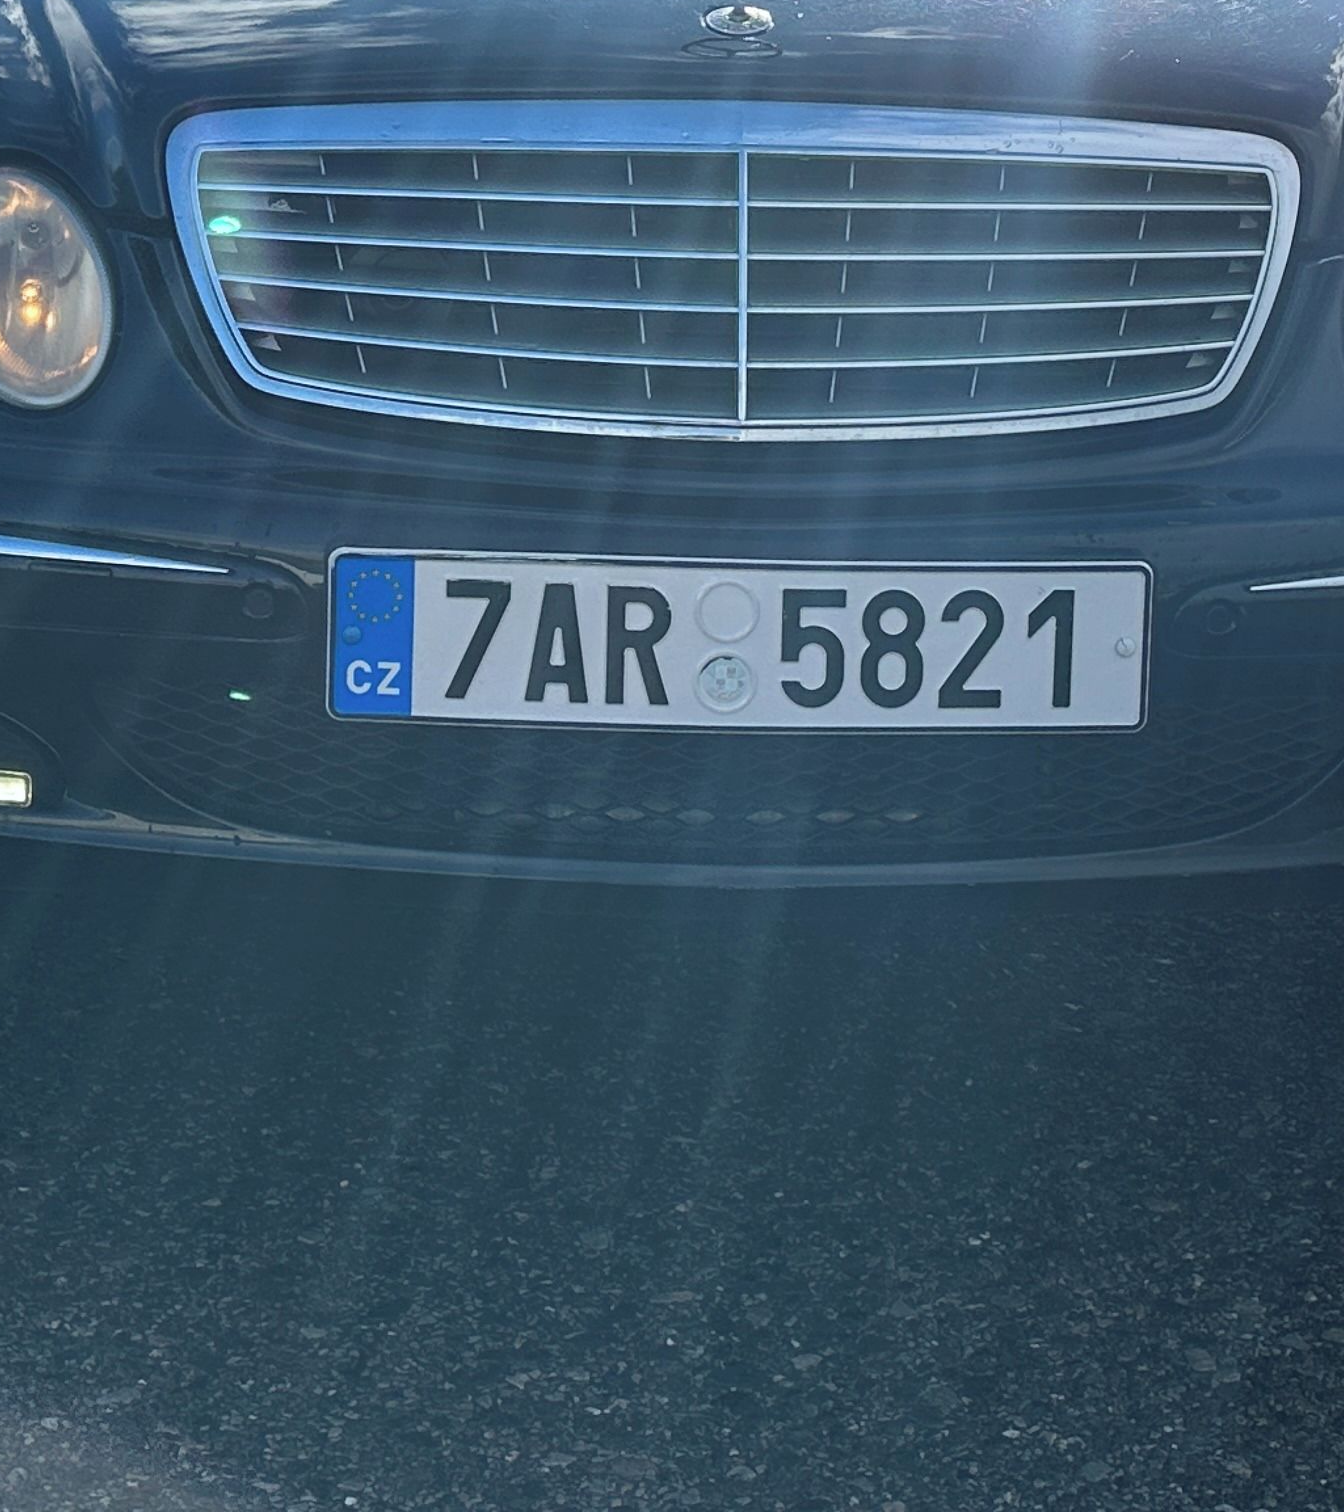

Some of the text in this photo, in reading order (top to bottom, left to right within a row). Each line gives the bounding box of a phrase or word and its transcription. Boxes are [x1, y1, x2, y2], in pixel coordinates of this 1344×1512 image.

[346, 578, 1076, 709] CZ 7AR 5821
